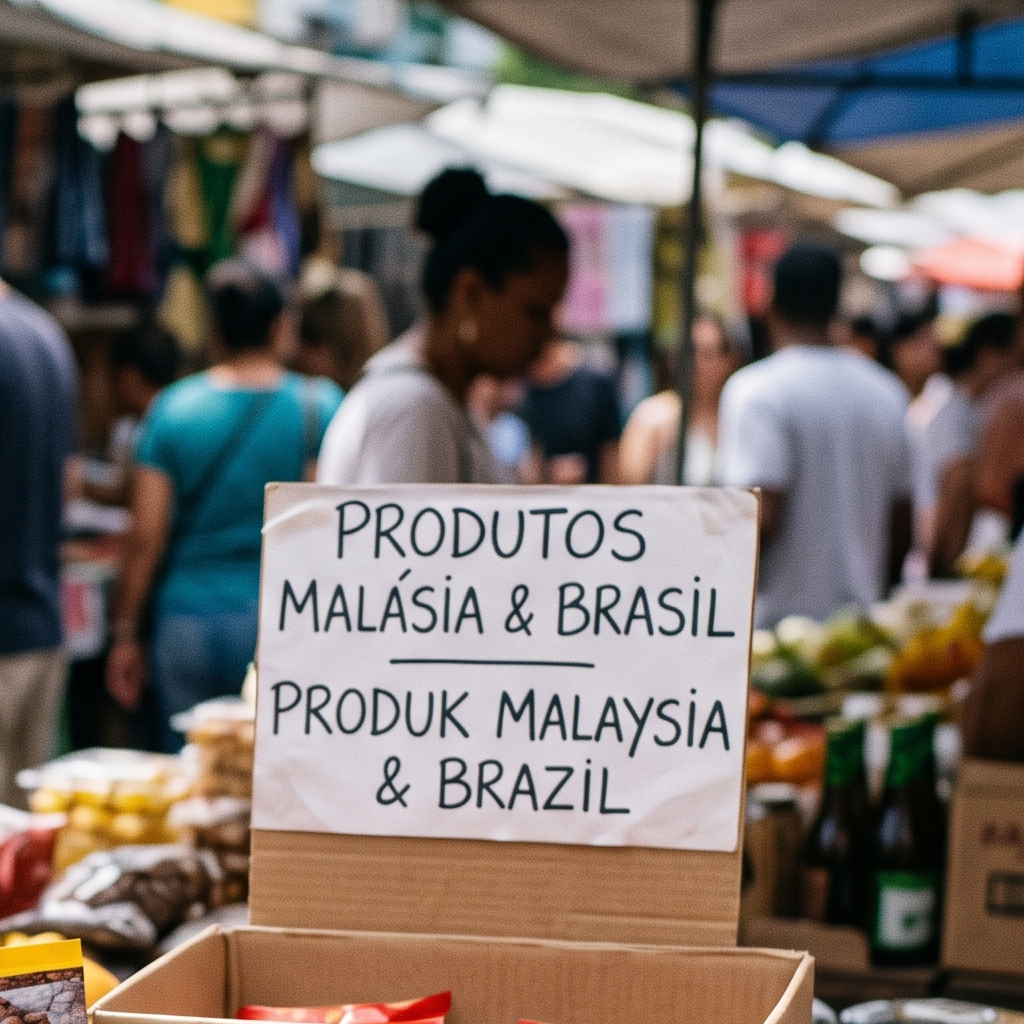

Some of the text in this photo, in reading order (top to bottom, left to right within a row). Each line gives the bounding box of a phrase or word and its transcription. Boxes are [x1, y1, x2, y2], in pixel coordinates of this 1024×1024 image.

[336, 501, 646, 561] PRODUTOS
[505, 585, 534, 636] &
[558, 576, 735, 638] BRASIL
[271, 681, 730, 757] PRODUK MALAYSIA
[376, 756, 630, 814] & BRAZIL
